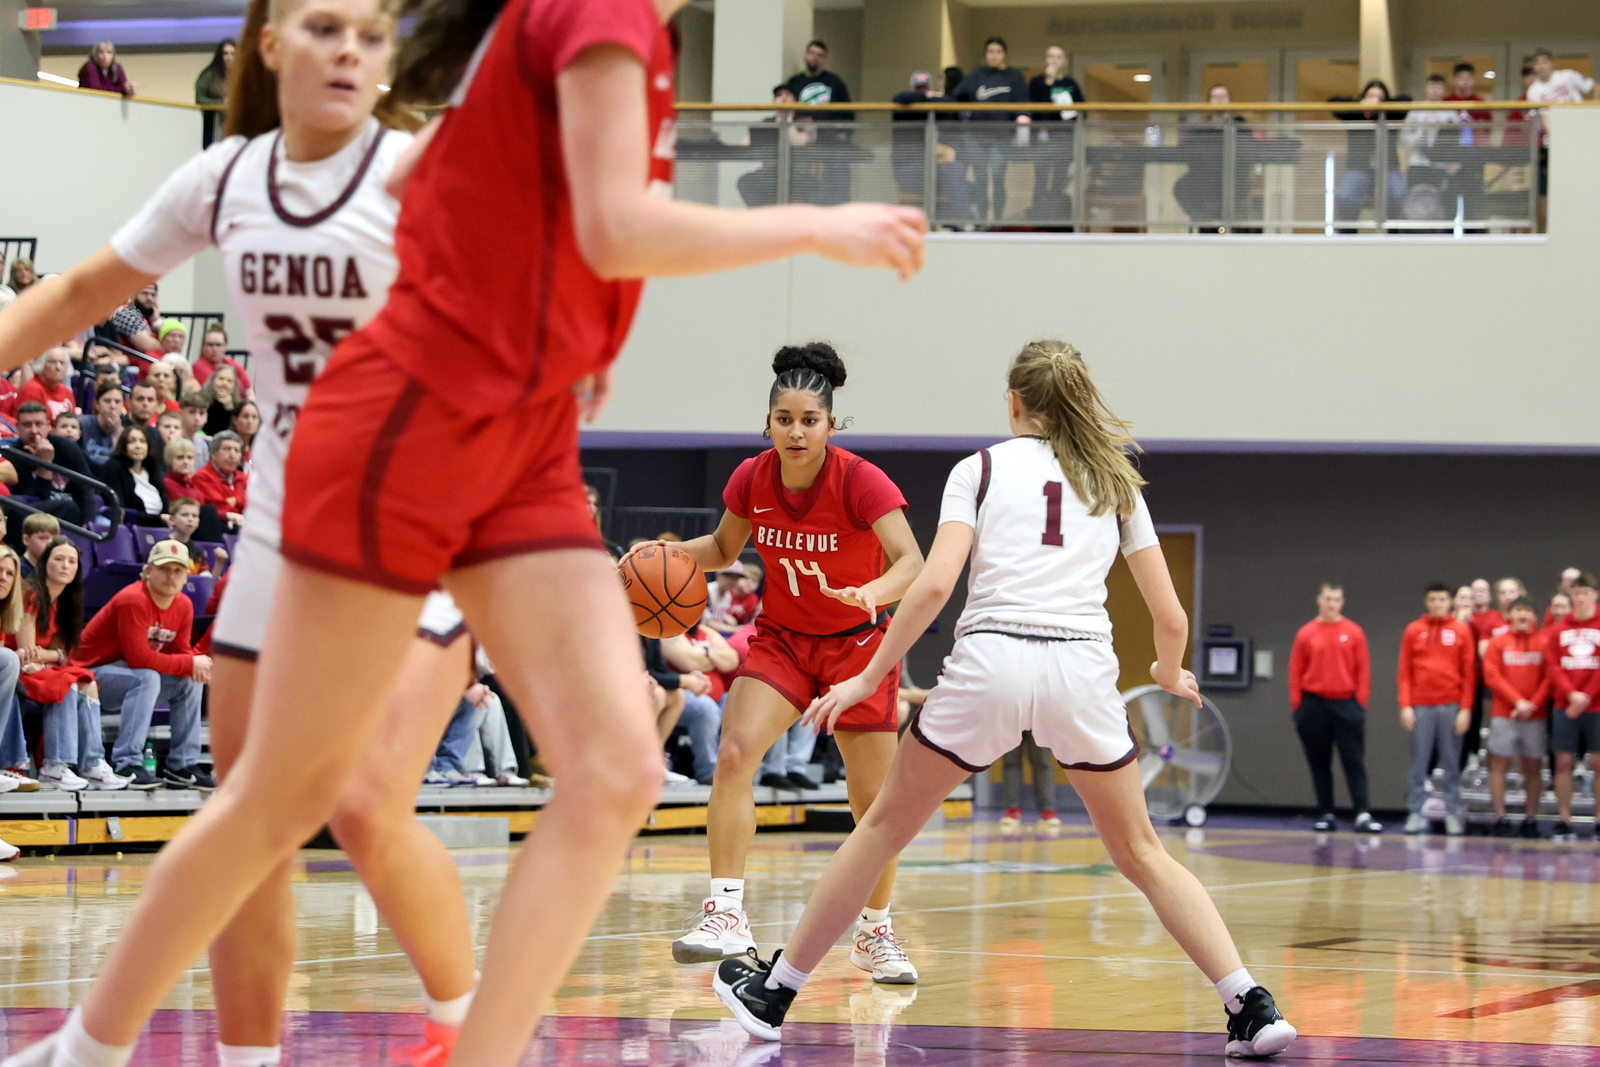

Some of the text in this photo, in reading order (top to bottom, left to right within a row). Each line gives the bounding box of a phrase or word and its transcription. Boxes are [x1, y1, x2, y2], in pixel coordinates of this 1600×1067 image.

[240, 252, 368, 299] GENOA
[1041, 480, 1064, 547] 1
[757, 525, 839, 553] BELLEVUE
[778, 557, 829, 597] 14
